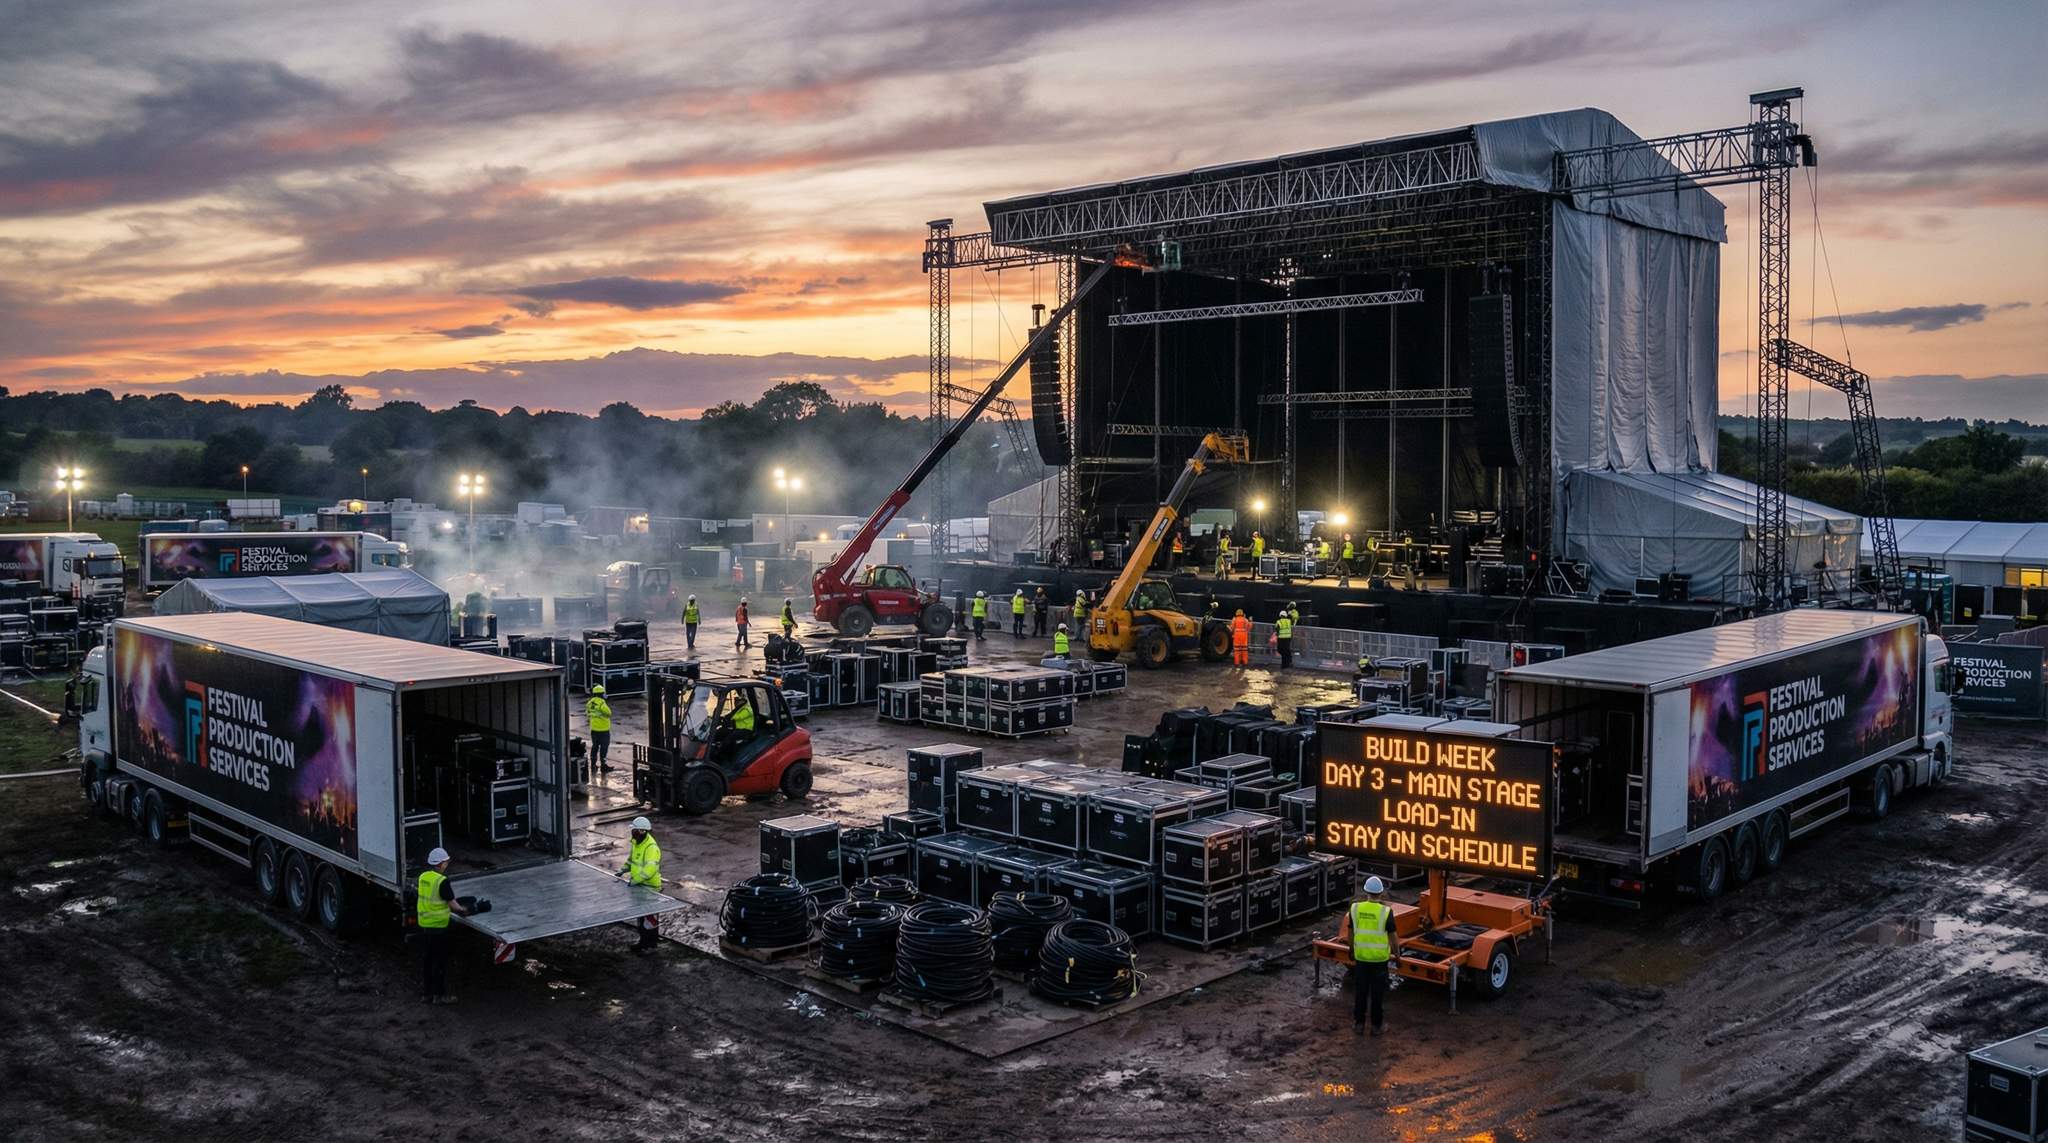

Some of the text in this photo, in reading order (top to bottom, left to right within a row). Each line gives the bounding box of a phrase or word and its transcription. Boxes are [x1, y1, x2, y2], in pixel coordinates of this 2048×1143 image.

[1953, 657, 2007, 669] FESTIVAL
[1963, 667, 2032, 680] RODUCTION
[1965, 677, 2007, 688] RVICES
[207, 686, 268, 728] FESTIVAL
[1769, 674, 1825, 713] FESTIVAL
[1769, 694, 1846, 743] PRODUCTION
[208, 716, 295, 769] PRODUCTION
[1366, 735, 1496, 772] BUILD WEEK
[1768, 729, 1825, 771] SERVICES
[209, 746, 270, 792] SERVICES
[1325, 761, 1365, 790] DAY
[1370, 767, 1385, 791] 3
[1408, 770, 1462, 800] MAIN
[1467, 776, 1541, 809] STAGE
[1383, 798, 1476, 832] LOAD-IN
[1327, 821, 1381, 851] STAY
[1387, 828, 1416, 855] ON
[1421, 833, 1538, 872] SCHEDULE
